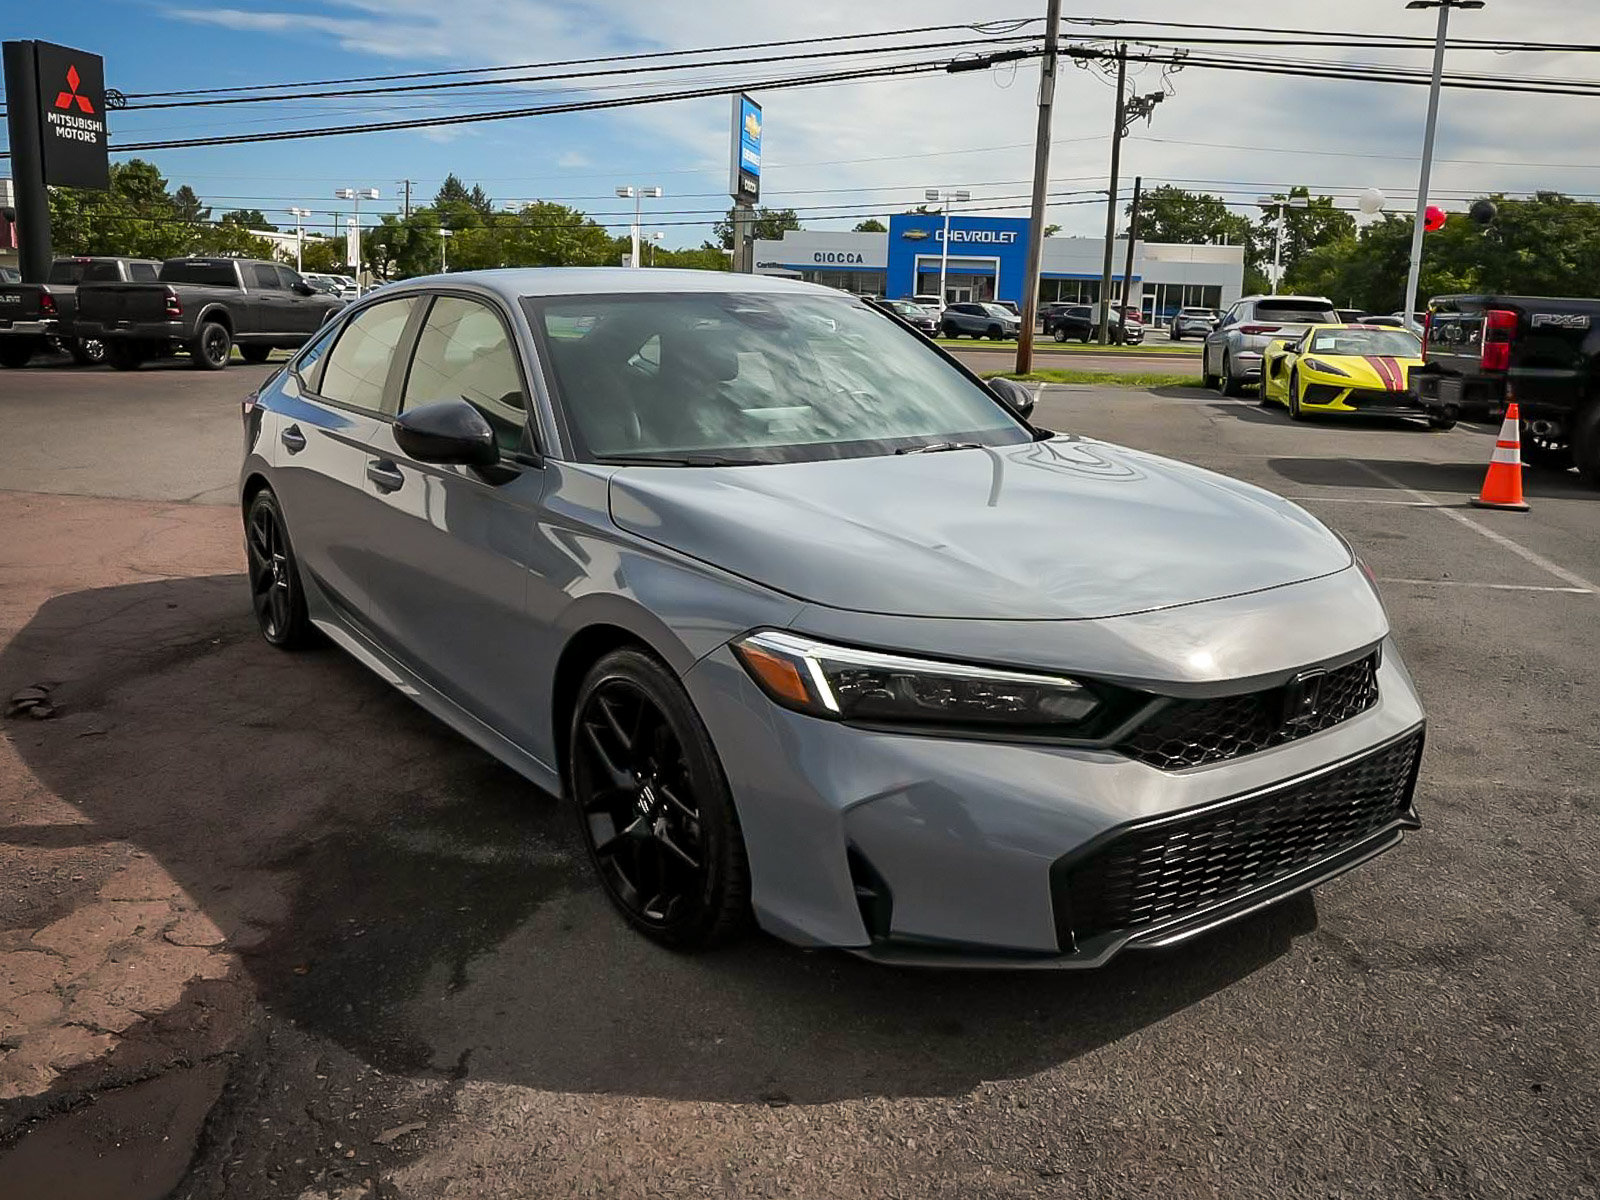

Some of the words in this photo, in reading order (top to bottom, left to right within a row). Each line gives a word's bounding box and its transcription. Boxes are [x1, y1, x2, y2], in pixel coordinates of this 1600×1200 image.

[47, 112, 103, 132] MITSUBISHI
[55, 126, 97, 143] MOTORS
[935, 229, 1018, 243] CHEVROLET
[813, 252, 864, 264] CIOCCA
